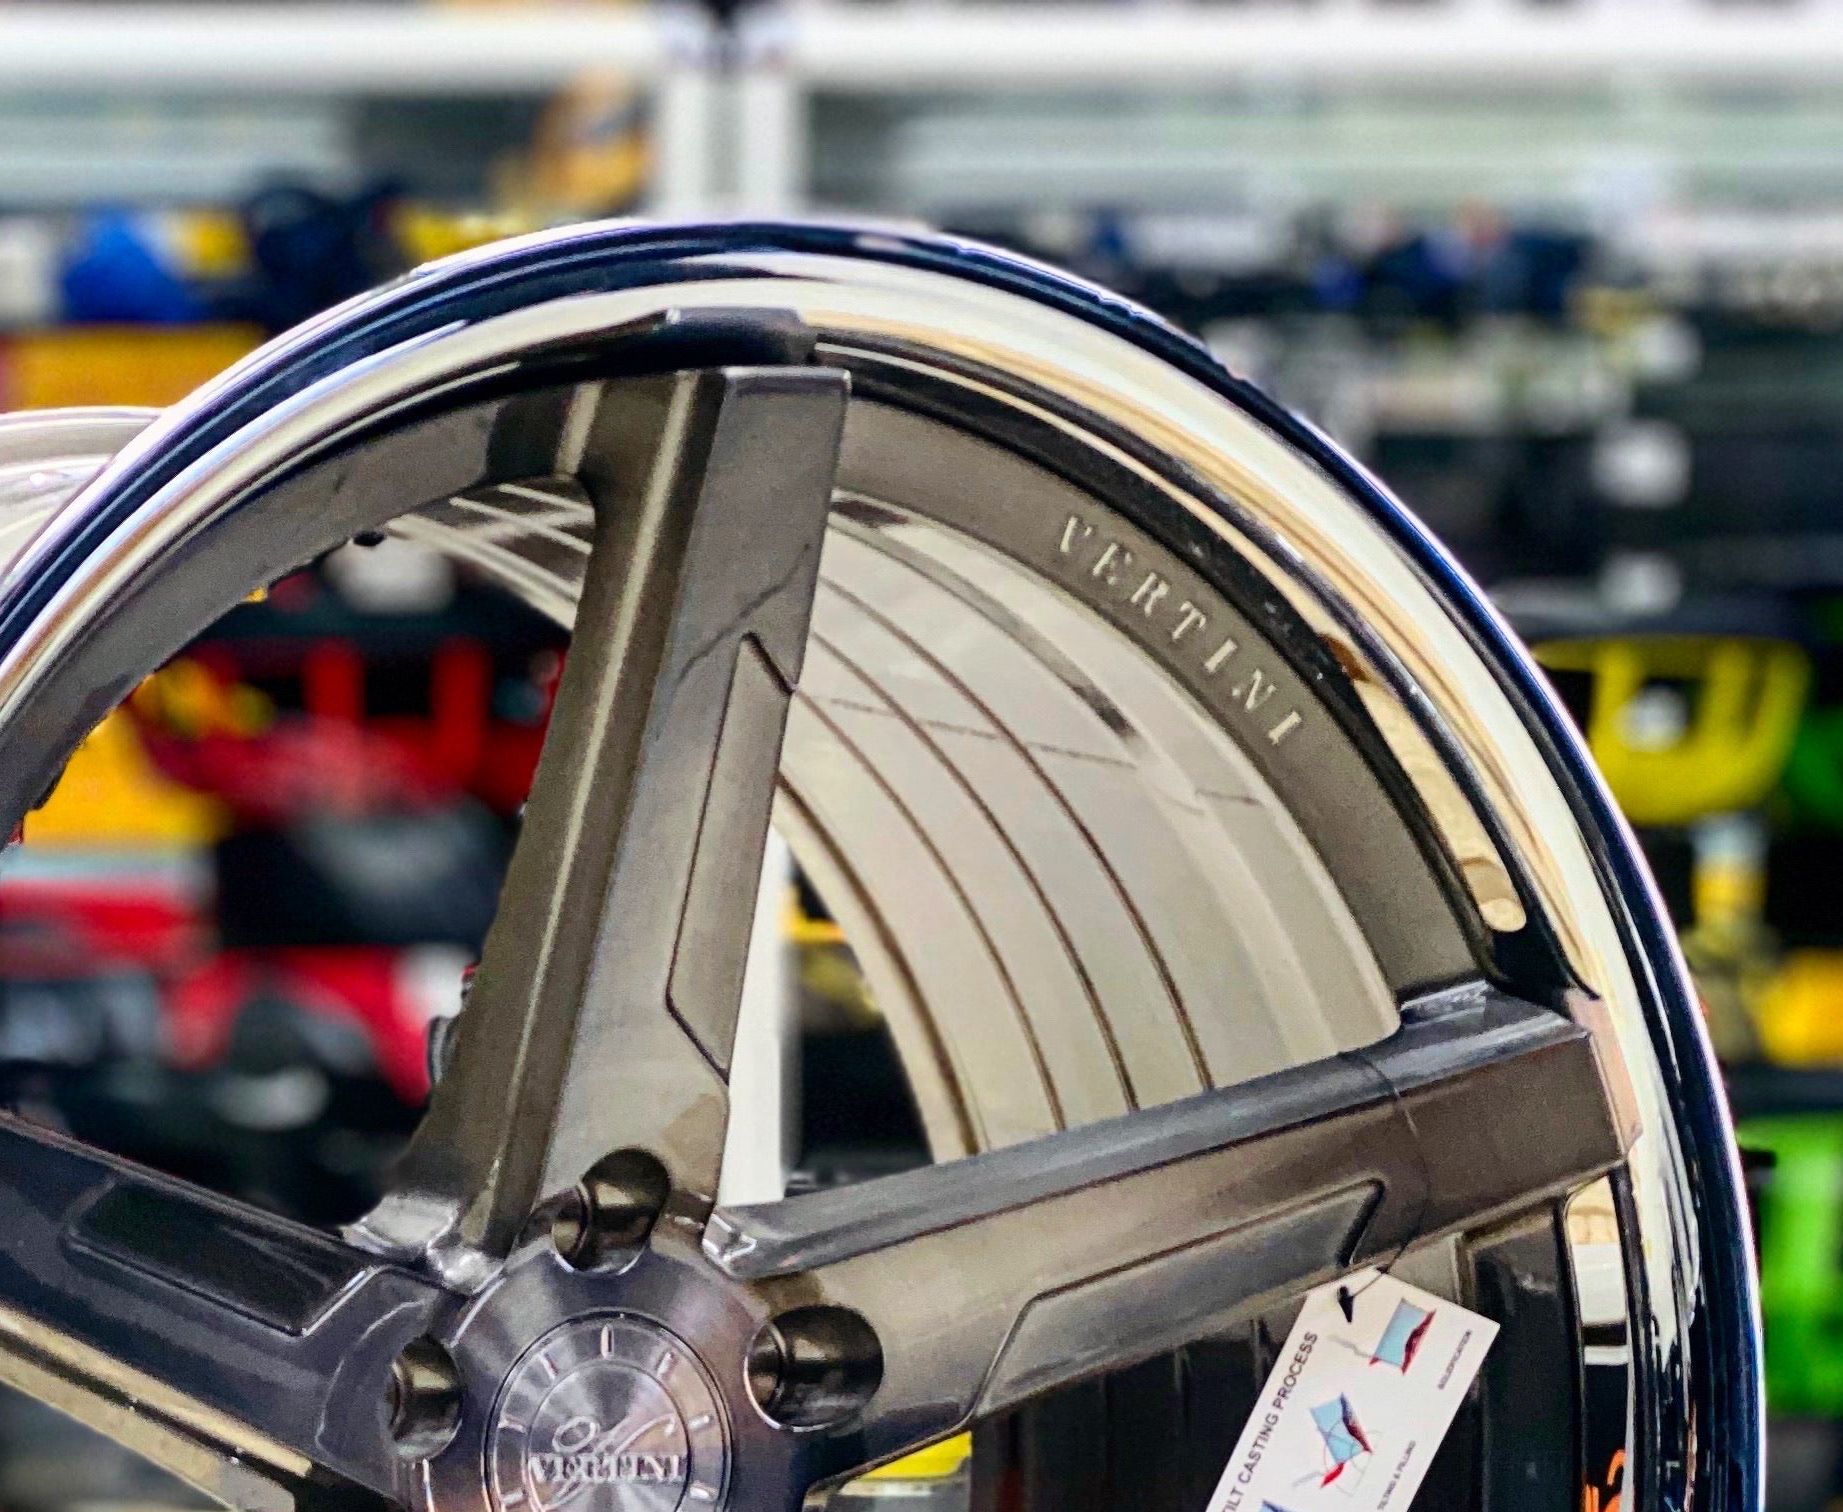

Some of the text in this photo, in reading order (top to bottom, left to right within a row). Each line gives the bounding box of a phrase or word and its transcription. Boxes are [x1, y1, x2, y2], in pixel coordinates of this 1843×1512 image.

[1060, 516, 1302, 745] VERTINI
[1238, 1412, 1279, 1485] CASTING
[1272, 1331, 1319, 1410] PROCESS
